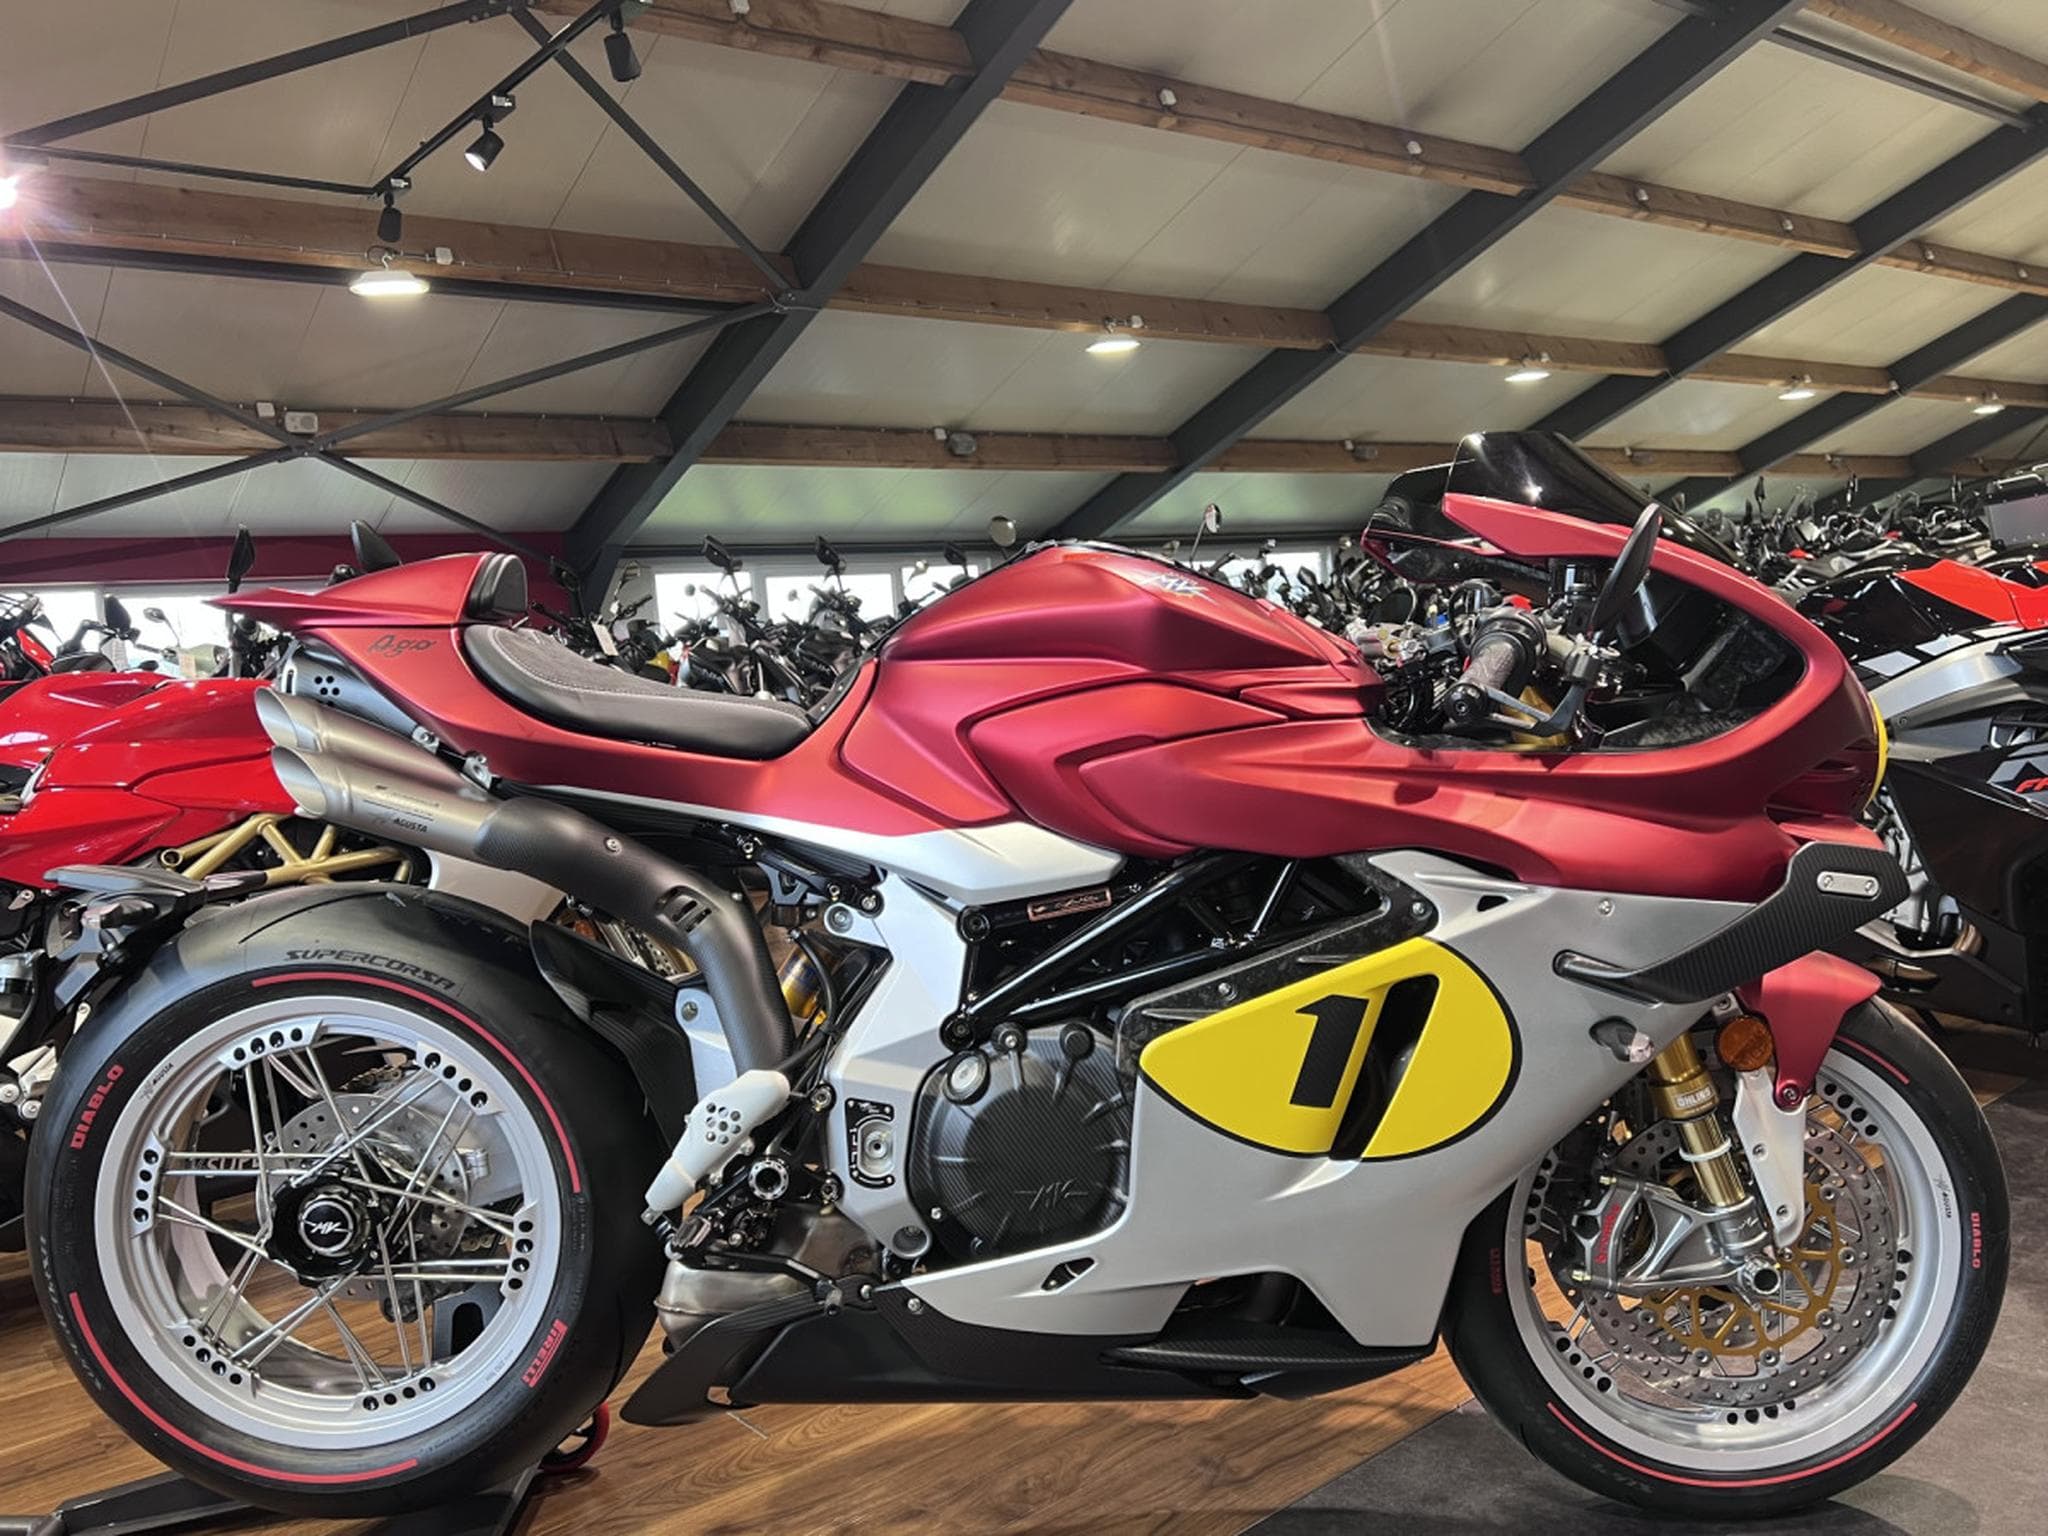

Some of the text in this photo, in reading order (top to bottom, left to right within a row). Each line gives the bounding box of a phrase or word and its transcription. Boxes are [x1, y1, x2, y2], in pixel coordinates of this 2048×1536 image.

[284, 949, 456, 991] SUPERCORSA
[1289, 994, 1370, 1109] 1
[70, 1064, 125, 1150] DIABLO
[1970, 1212, 1982, 1269] DIABLO
